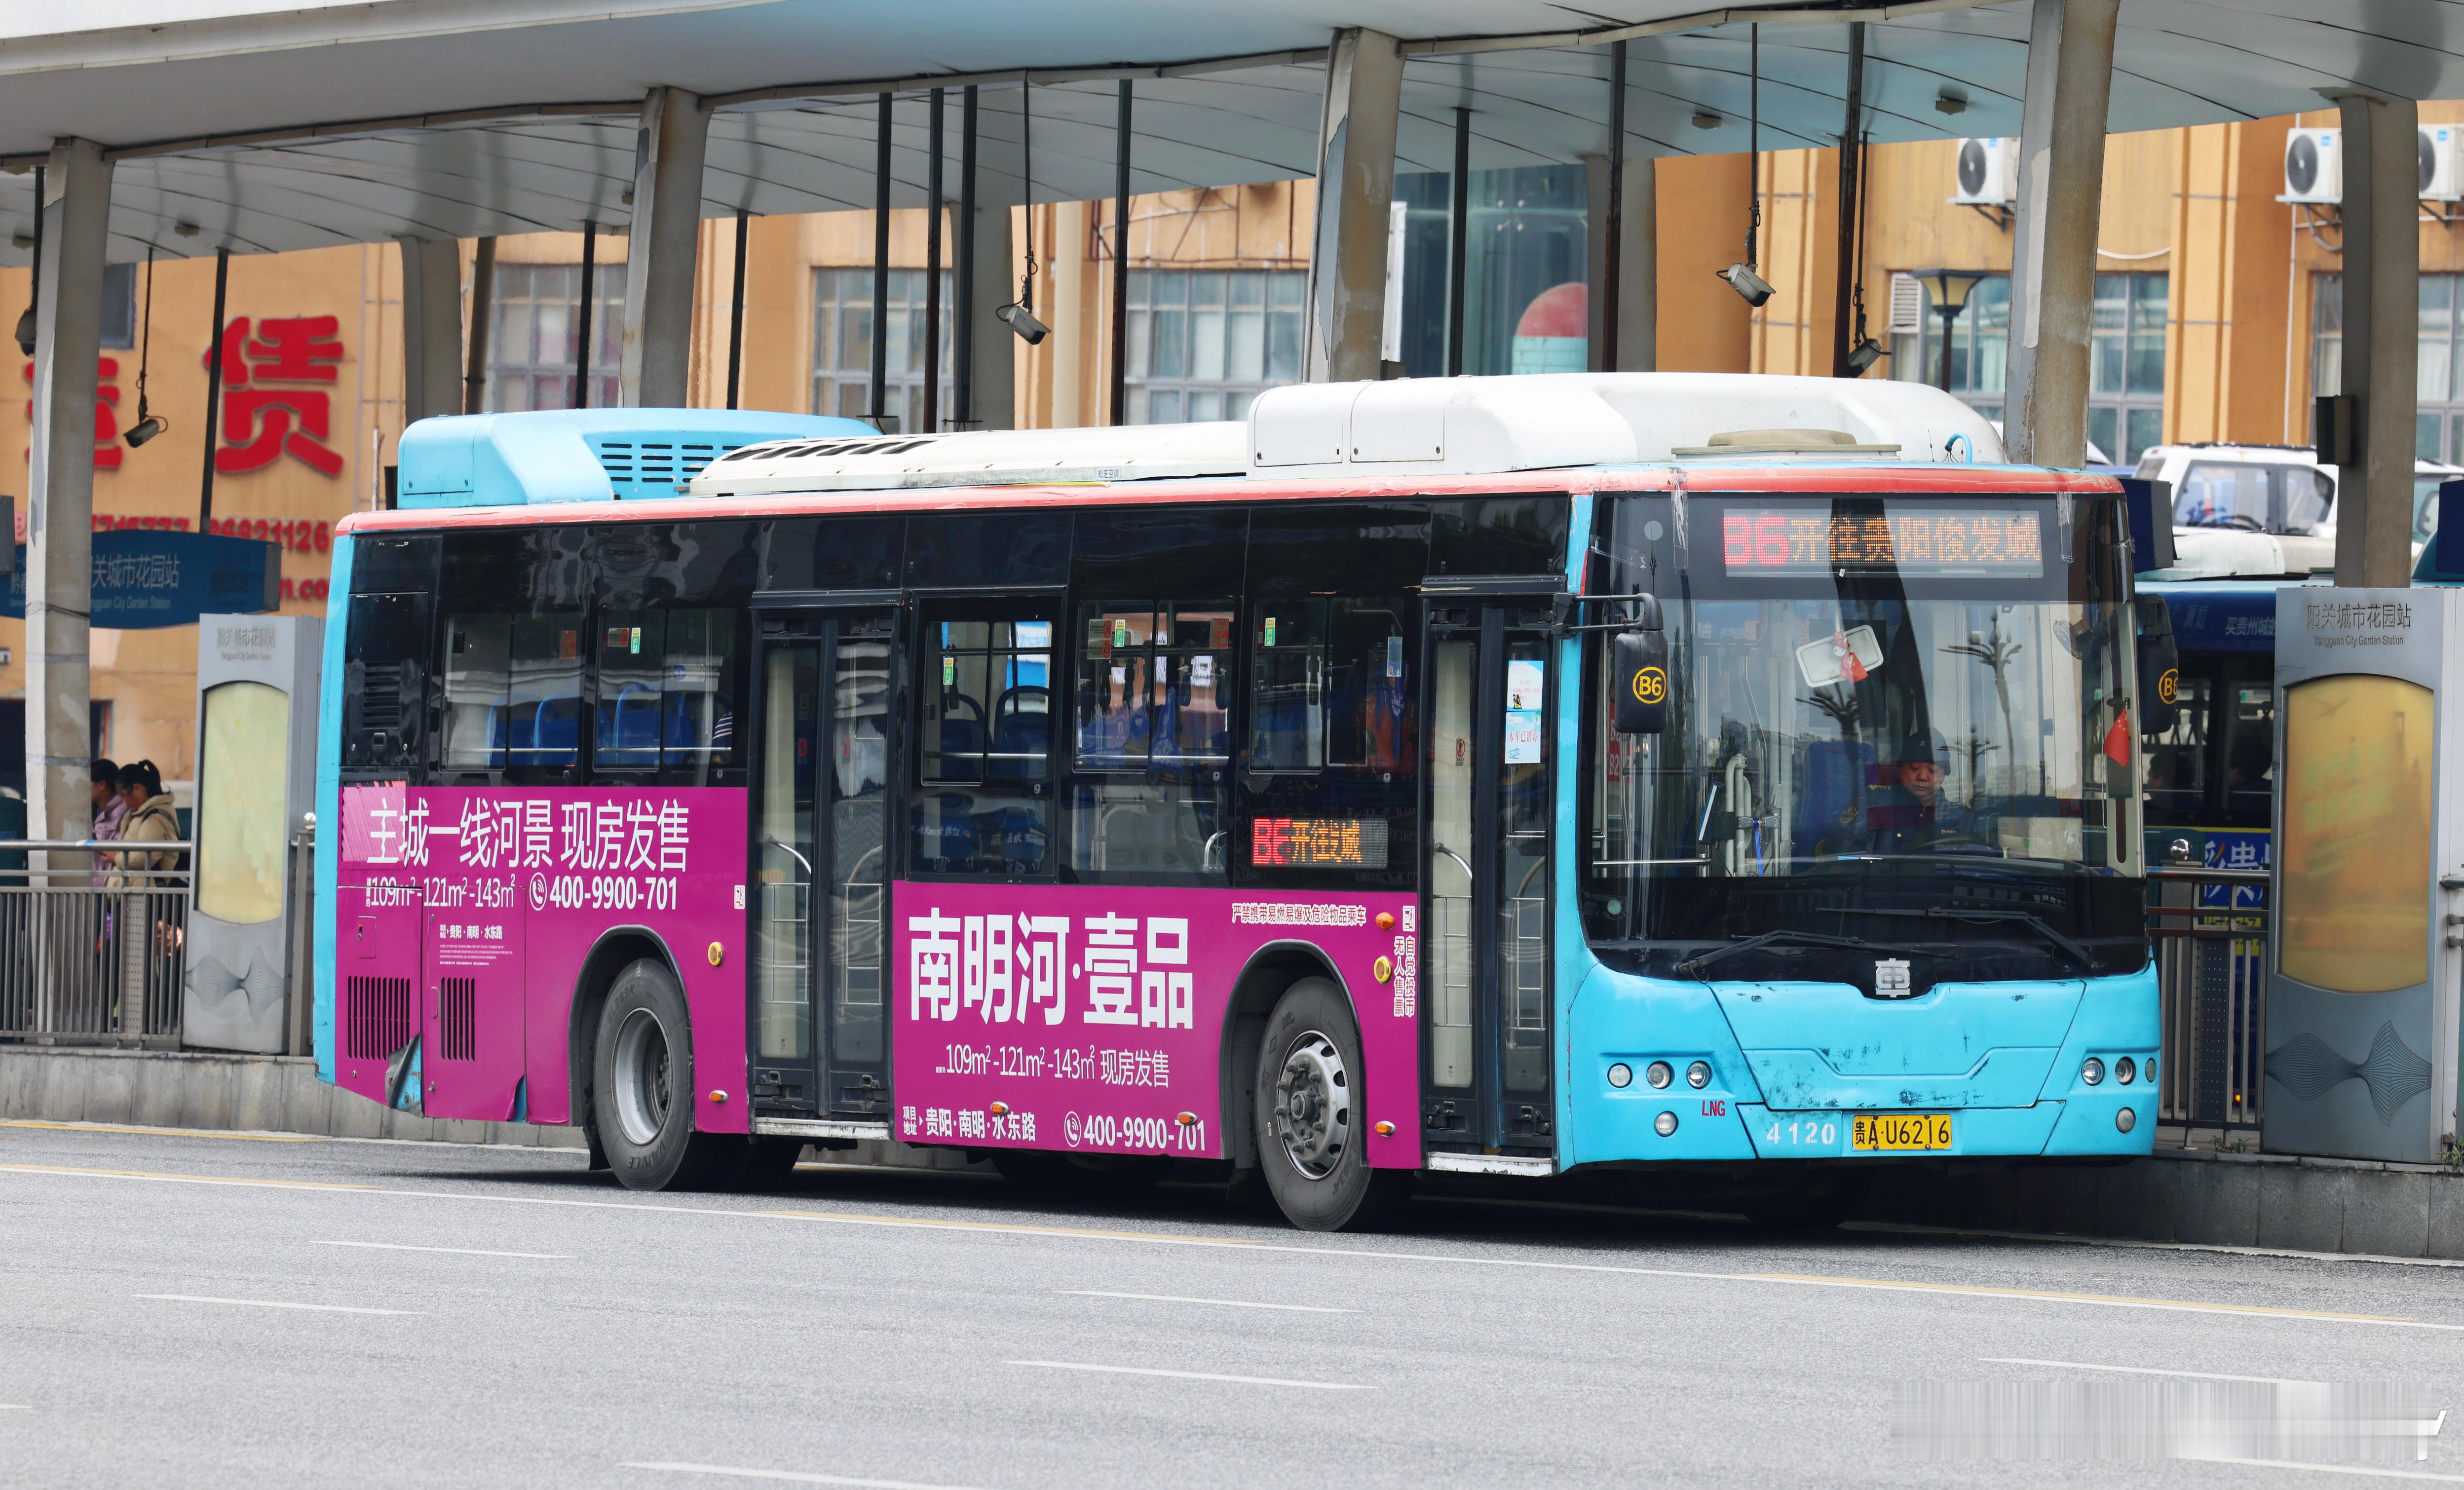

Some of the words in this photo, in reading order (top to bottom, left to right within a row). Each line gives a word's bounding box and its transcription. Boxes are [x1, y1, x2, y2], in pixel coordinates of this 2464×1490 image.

[1098, 469, 1119, 479] 松芝空调
[91, 554, 180, 589] 关城市花园站
[2308, 603, 2412, 629] 阳关城市花园站
[2314, 635, 2344, 648] Yangguan
[2346, 635, 2357, 648] City
[2358, 635, 2381, 645] Garden
[2383, 635, 2404, 645] Station
[1639, 676, 1663, 696] B6
[1509, 730, 1538, 743] 本车已消毒
[367, 797, 553, 868] 主城一线河景
[560, 799, 689, 872] 现房发售
[549, 876, 677, 910] 400-9900-701
[1233, 904, 1366, 926] 严禁携带易燃易爆及危险物品乘车
[1394, 936, 1405, 1017] 无人售票
[1405, 936, 1416, 1017] 自觉投币
[1100, 1049, 1170, 1088] 现房发售
[903, 1106, 916, 1121] 项目
[1702, 1100, 1726, 1117] LNG
[903, 1121, 917, 1135] 地址
[1084, 1115, 1206, 1151] 400-9900-701
[1766, 1122, 1835, 1145] 4120
